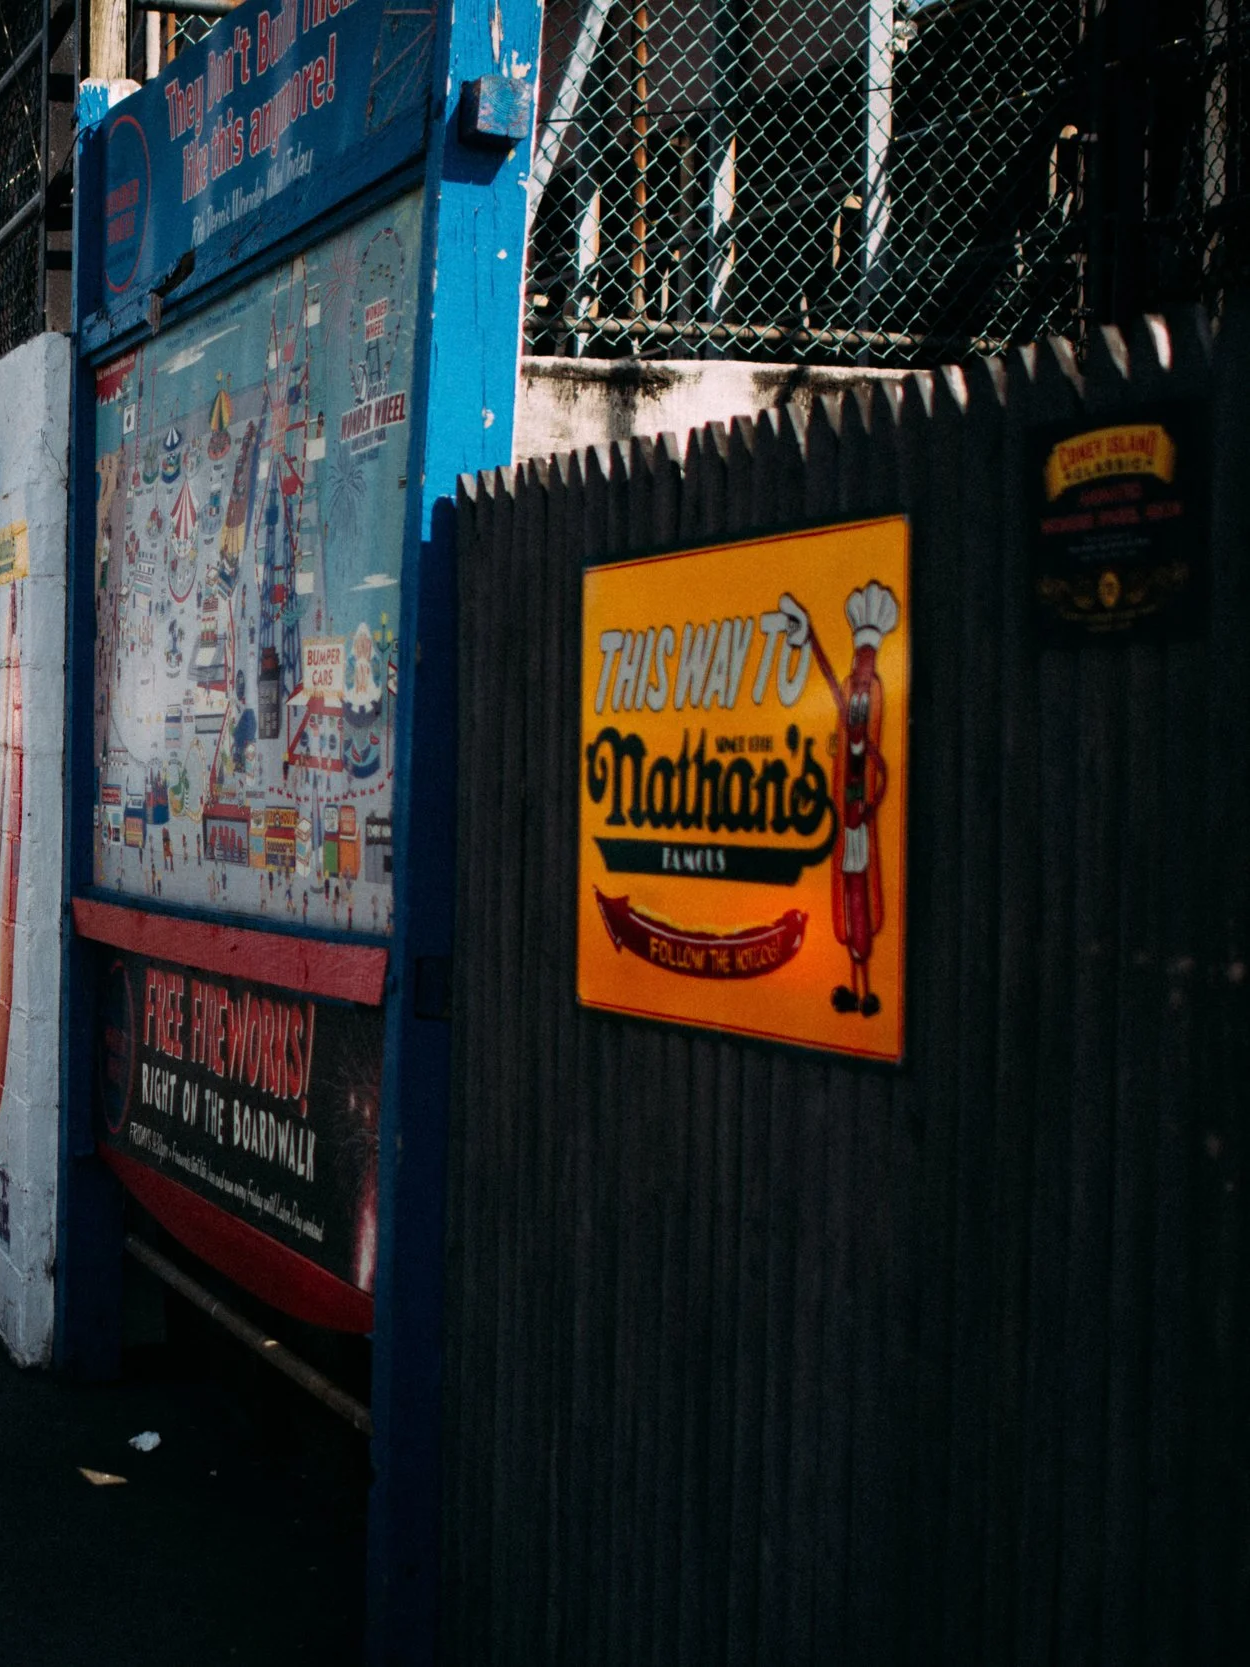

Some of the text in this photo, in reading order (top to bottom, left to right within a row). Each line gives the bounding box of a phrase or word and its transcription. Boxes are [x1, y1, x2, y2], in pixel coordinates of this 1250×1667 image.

[165, 76, 203, 141] They
[207, 26, 250, 113] Don't
[256, 0, 297, 76] Build
[182, 32, 337, 204] like this anymore!
[341, 393, 406, 439] WONDER WHEEL
[306, 648, 341, 666] BUMPER
[311, 669, 333, 687] CARS
[594, 609, 814, 714] THIS WAY TO
[586, 723, 832, 837] Nathan's
[661, 846, 727, 873] FAMOUS
[650, 935, 705, 971] FOLLOW
[709, 948, 732, 974] THE
[143, 967, 185, 1060] FREE
[190, 980, 317, 1118] FIREWORKS!
[141, 1062, 317, 1182] RIGHT ON THE BOARDWALK
